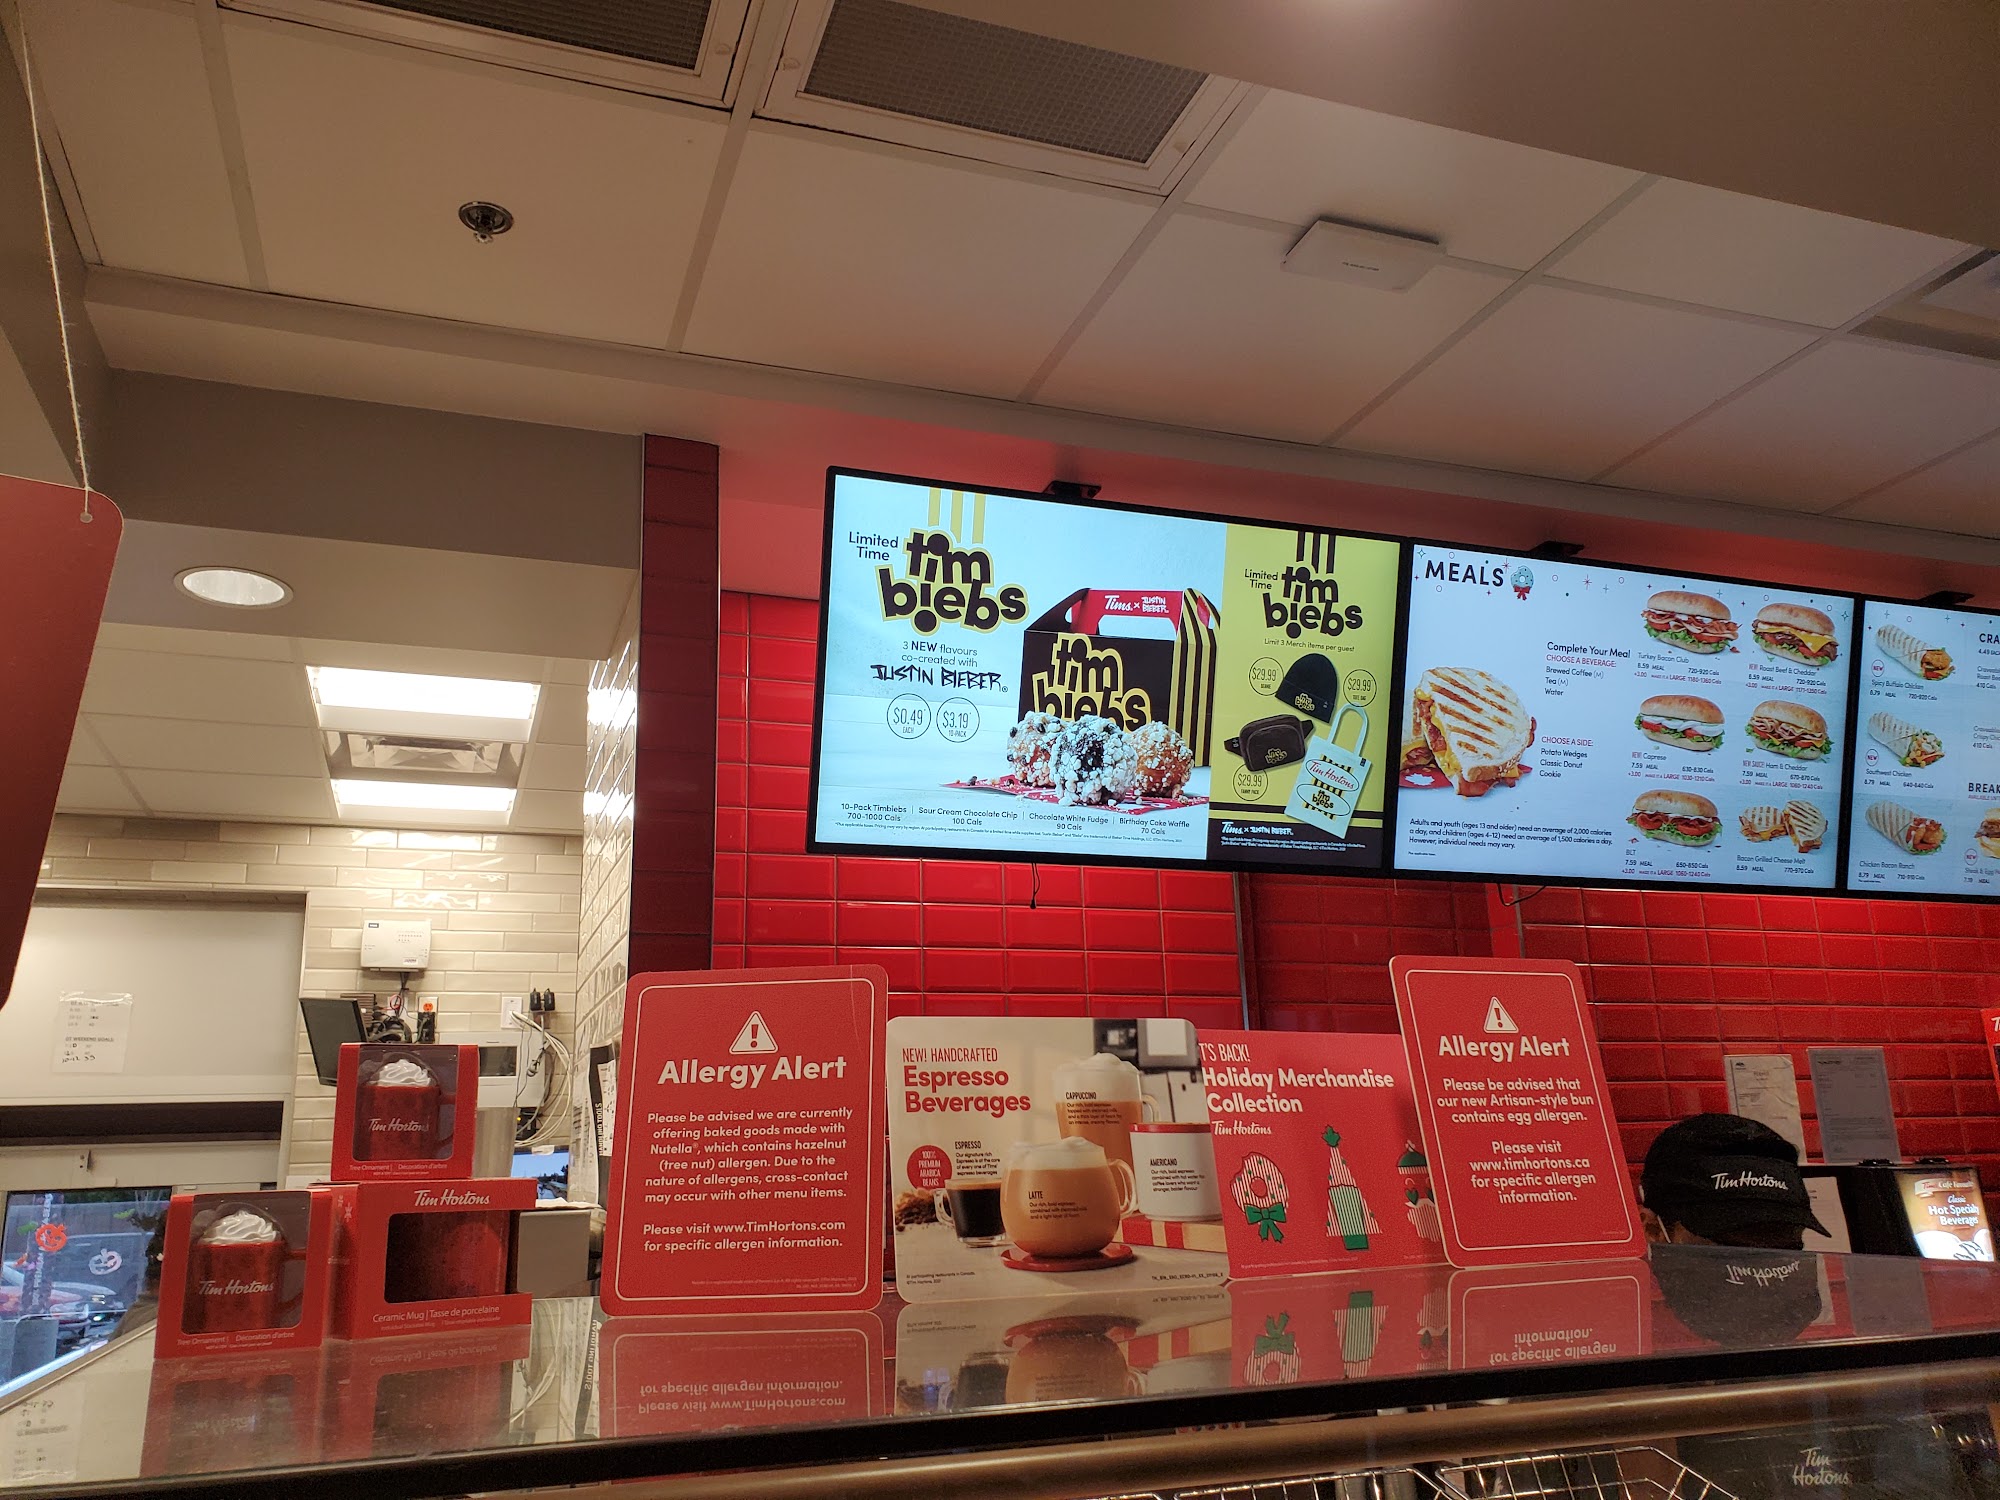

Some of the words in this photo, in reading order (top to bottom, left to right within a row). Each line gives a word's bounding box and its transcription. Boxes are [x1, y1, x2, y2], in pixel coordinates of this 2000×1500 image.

[849, 532, 899, 548] Limited
[856, 547, 890, 561] Time
[906, 532, 992, 583] tim
[1245, 569, 1278, 580] Limited
[1425, 560, 1504, 586] MEALS
[1250, 579, 1272, 590] Time
[1282, 566, 1338, 603] tim
[903, 641, 908, 649] 3
[911, 641, 937, 652] NEW
[939, 643, 977, 656] flavours
[1286, 640, 1306, 648] Merch
[1547, 642, 1588, 654] Complete
[1589, 646, 1608, 656] Your
[1610, 649, 1630, 658] Meal
[901, 653, 955, 665] co-created
[957, 656, 978, 667] with
[1546, 654, 1575, 664] CHOOSE
[1576, 656, 1580, 664] A
[1582, 658, 1617, 668] BEVERAGE:
[870, 664, 933, 684] JUSTIN
[1546, 666, 1570, 675] Brewed
[1571, 668, 1592, 677] Coffee
[1594, 670, 1603, 679] (M)
[1545, 677, 1556, 685] Tea
[1545, 688, 1563, 696] Water
[1542, 737, 1570, 745] CHOOSE
[1541, 748, 1561, 756] Potato
[1563, 750, 1587, 759] Wedges
[1540, 759, 1562, 767] Classic
[841, 803, 872, 811] 10-Pack
[873, 805, 906, 813] Timbiebs
[1002, 811, 1018, 819] Chip
[1029, 813, 1064, 821] Chocolate
[1119, 818, 1148, 826] Birthday
[902, 1048, 927, 1062] NEW!
[931, 1048, 997, 1062] HANDCRAFTED
[1199, 1043, 1217, 1062] T'S
[1219, 1044, 1250, 1062] BACK!
[1439, 1035, 1514, 1062] Allergy
[1519, 1036, 1570, 1056] Alert
[658, 1059, 766, 1089] Allergy
[772, 1056, 847, 1080] Alert
[904, 1065, 1009, 1093] Espresso
[1203, 1067, 1273, 1092] Holiday
[1278, 1068, 1394, 1087] Merchandise
[1443, 1079, 1485, 1091] Please
[1488, 1079, 1504, 1090] be
[1507, 1078, 1554, 1090] advised
[1556, 1078, 1580, 1090] that
[905, 1090, 1031, 1118] Beverages
[1207, 1093, 1303, 1112] Collection
[1437, 1097, 1458, 1107] our
[1461, 1098, 1487, 1106] new
[1490, 1093, 1568, 1108] Artisan-style
[1571, 1094, 1594, 1105] bun
[648, 1112, 686, 1123] Please
[689, 1112, 705, 1122] be
[708, 1111, 754, 1121] advised
[776, 1110, 796, 1118] are
[800, 1107, 853, 1119] currently
[1452, 1111, 1504, 1123] contains
[1508, 1113, 1531, 1125] egg
[1534, 1110, 1587, 1124] allergen.
[368, 1118, 387, 1132] Tim
[388, 1118, 429, 1132] Hortons
[653, 1127, 700, 1140] offering
[704, 1125, 741, 1137] baked
[744, 1125, 780, 1139] goods
[784, 1124, 817, 1135] made
[820, 1123, 845, 1133] with
[1212, 1120, 1232, 1135] Tim
[1234, 1120, 1272, 1135] Hortons
[704, 1142, 738, 1153] which
[742, 1140, 792, 1151] contains
[795, 1139, 847, 1149] hazelnut
[955, 1141, 981, 1149] ESPRESSO
[1492, 1141, 1534, 1154] Please
[1536, 1141, 1562, 1153] visit
[659, 1158, 688, 1171] (tree
[691, 1158, 715, 1170] nut)
[718, 1156, 770, 1170] allergen.
[774, 1157, 798, 1167] Due
[801, 1157, 813, 1166] to
[816, 1155, 835, 1165] the
[1150, 1158, 1177, 1167] AMERICANO
[1469, 1157, 1590, 1171] www.timhortons.ca
[645, 1176, 685, 1186] nature
[688, 1174, 701, 1185] of
[704, 1174, 762, 1186] allergens,
[765, 1171, 848, 1183] cross-contact
[1471, 1175, 1489, 1188] for
[1492, 1174, 1542, 1189] specific
[1545, 1173, 1596, 1188] allergen
[1711, 1173, 1738, 1190] Tim
[1738, 1171, 1789, 1190] Hortons
[414, 1190, 438, 1207] Tim
[439, 1189, 489, 1205] Hortons
[645, 1193, 670, 1204] may
[674, 1192, 707, 1201] occur
[711, 1190, 735, 1200] with
[739, 1189, 771, 1199] other
[774, 1189, 807, 1198] menu
[810, 1187, 847, 1198] items.
[1028, 1191, 1043, 1199] LATTE
[1499, 1189, 1577, 1204] information.
[643, 1224, 683, 1235] Please
[686, 1223, 710, 1234] visit
[713, 1220, 845, 1233] www.TimHortons.com
[644, 1240, 662, 1252] for
[664, 1240, 711, 1253] specific
[714, 1238, 765, 1251] allergen
[768, 1237, 842, 1249] information.
[198, 1280, 223, 1296] Tim
[224, 1279, 273, 1295] Hortons
[372, 1313, 402, 1324] Ceramic
[405, 1310, 424, 1324] Mug
[429, 1309, 448, 1320] Tasse
[450, 1309, 461, 1319] de
[462, 1305, 499, 1321] porcelaine
[1800, 1447, 1832, 1467] Tim
[1792, 1467, 1850, 1486] Hortons
